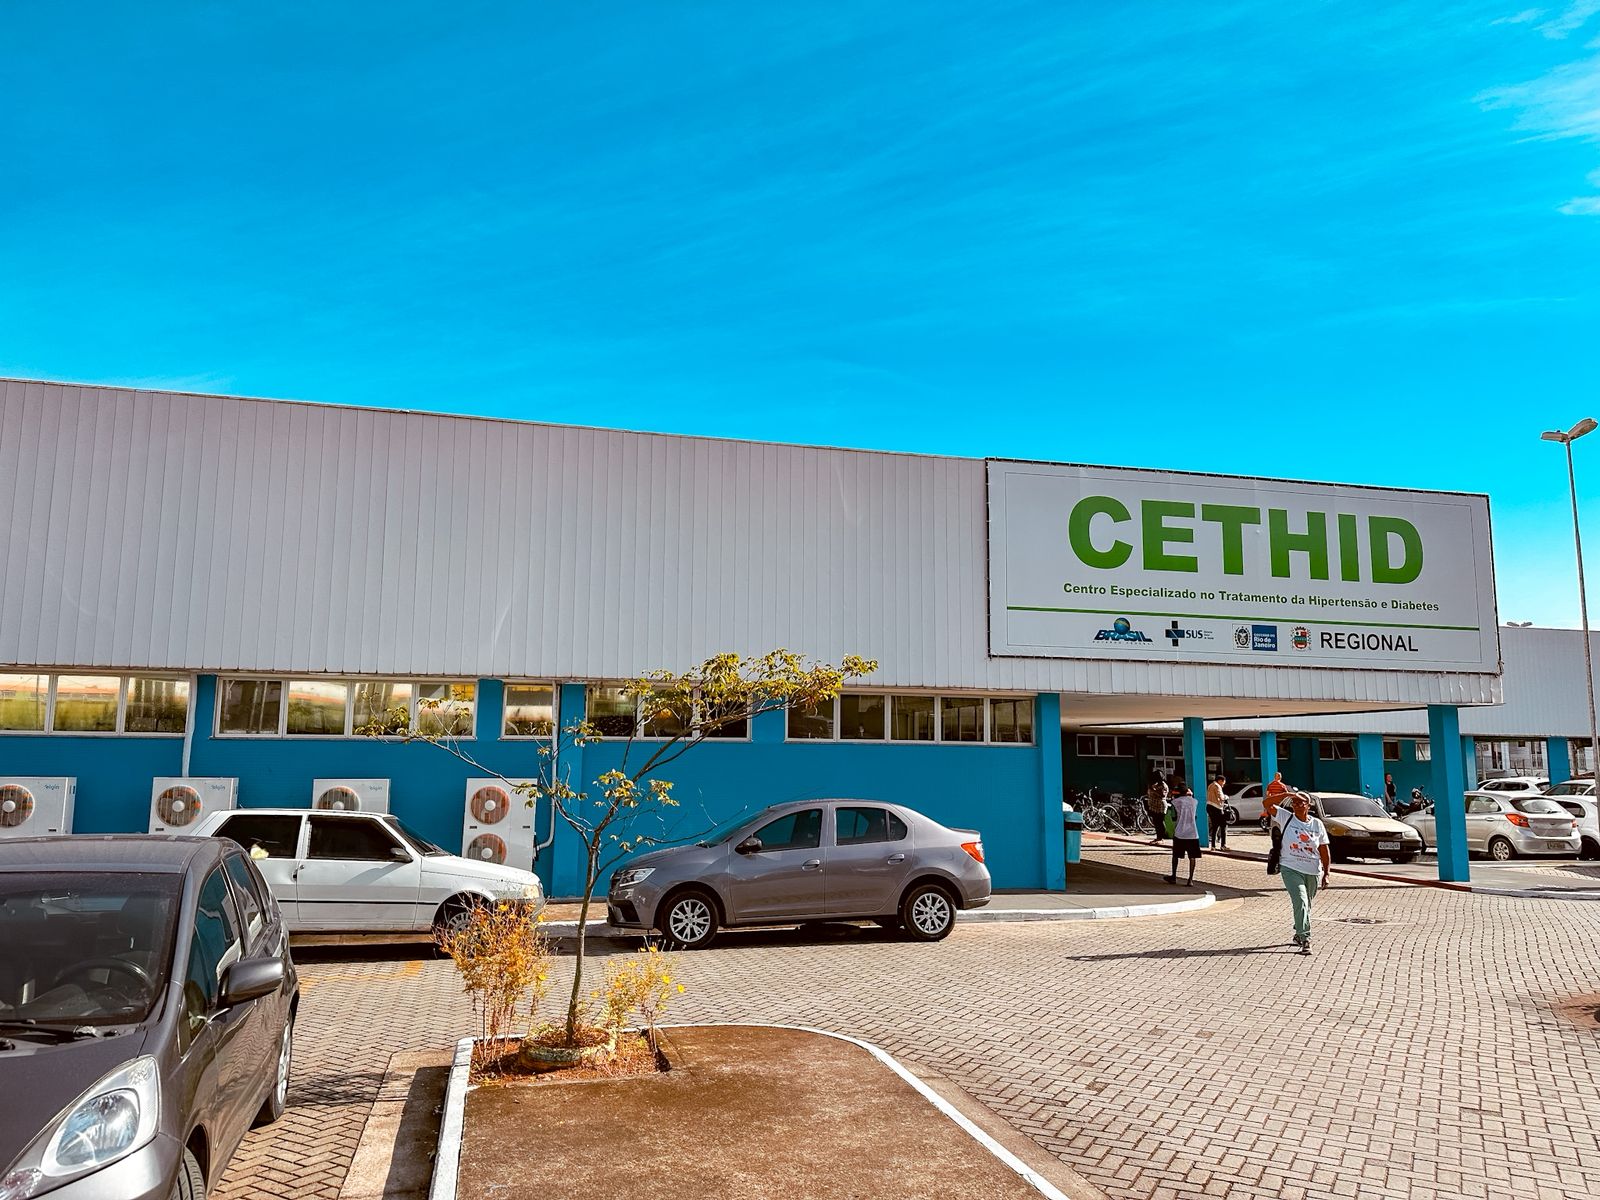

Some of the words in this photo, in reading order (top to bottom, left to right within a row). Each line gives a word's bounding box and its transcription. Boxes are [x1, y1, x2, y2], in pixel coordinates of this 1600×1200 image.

[1069, 496, 1423, 584] CETHID
[1063, 583, 1106, 595] Centro
[1110, 585, 1196, 600] Especializado
[1200, 591, 1215, 600] no
[1219, 591, 1287, 605] Tratamento
[1290, 593, 1305, 605] da
[1308, 595, 1378, 611] Hipertensão
[1380, 600, 1388, 609] e
[1391, 600, 1440, 612] Diabetes
[1094, 630, 1153, 642] BRASIL
[1186, 629, 1203, 639] SUS
[1320, 631, 1419, 652] REGIONAL
